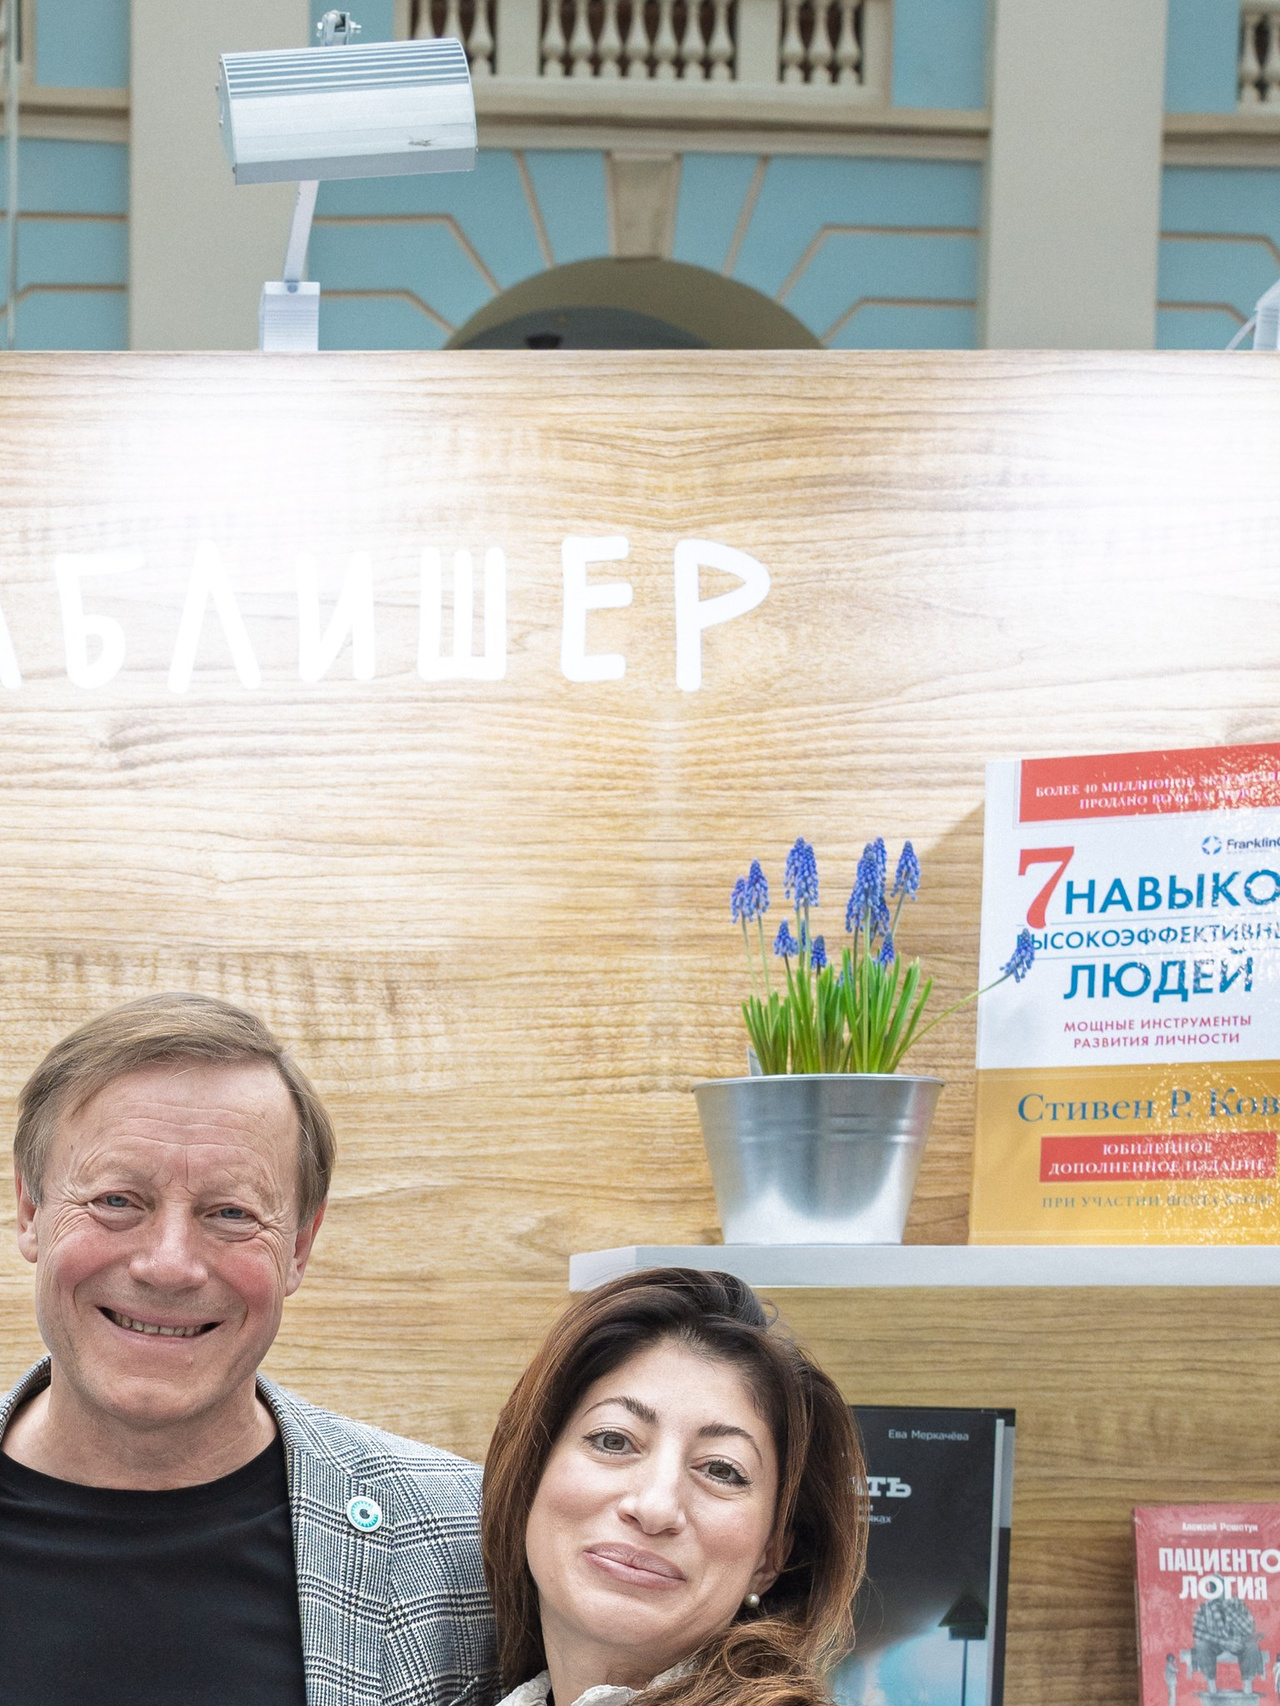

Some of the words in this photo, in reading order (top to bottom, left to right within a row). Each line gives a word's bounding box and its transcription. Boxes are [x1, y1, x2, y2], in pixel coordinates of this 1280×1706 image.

[1035, 784, 1080, 798] БОЛЕЕ
[1083, 784, 1098, 794] 40
[1079, 795, 1148, 810] ПРОДАНО
[1018, 846, 1074, 929] 7
[1063, 946, 1255, 1003] ЛЮДЕЙ
[1063, 1018, 1135, 1033] МОЩНЫЕ
[1141, 1015, 1252, 1030] ИНСТРУМЕНТЫ
[1074, 1036, 1149, 1049] РАЗВИТИЯ
[1155, 1032, 1240, 1046] ЛИЧНОСТИ
[1017, 1092, 1154, 1123] Стивен
[888, 1429, 908, 1440] Ева
[1158, 1547, 1280, 1576] ПАЦИЕНТО
[1179, 1575, 1268, 1601] ЛОГИЯ
